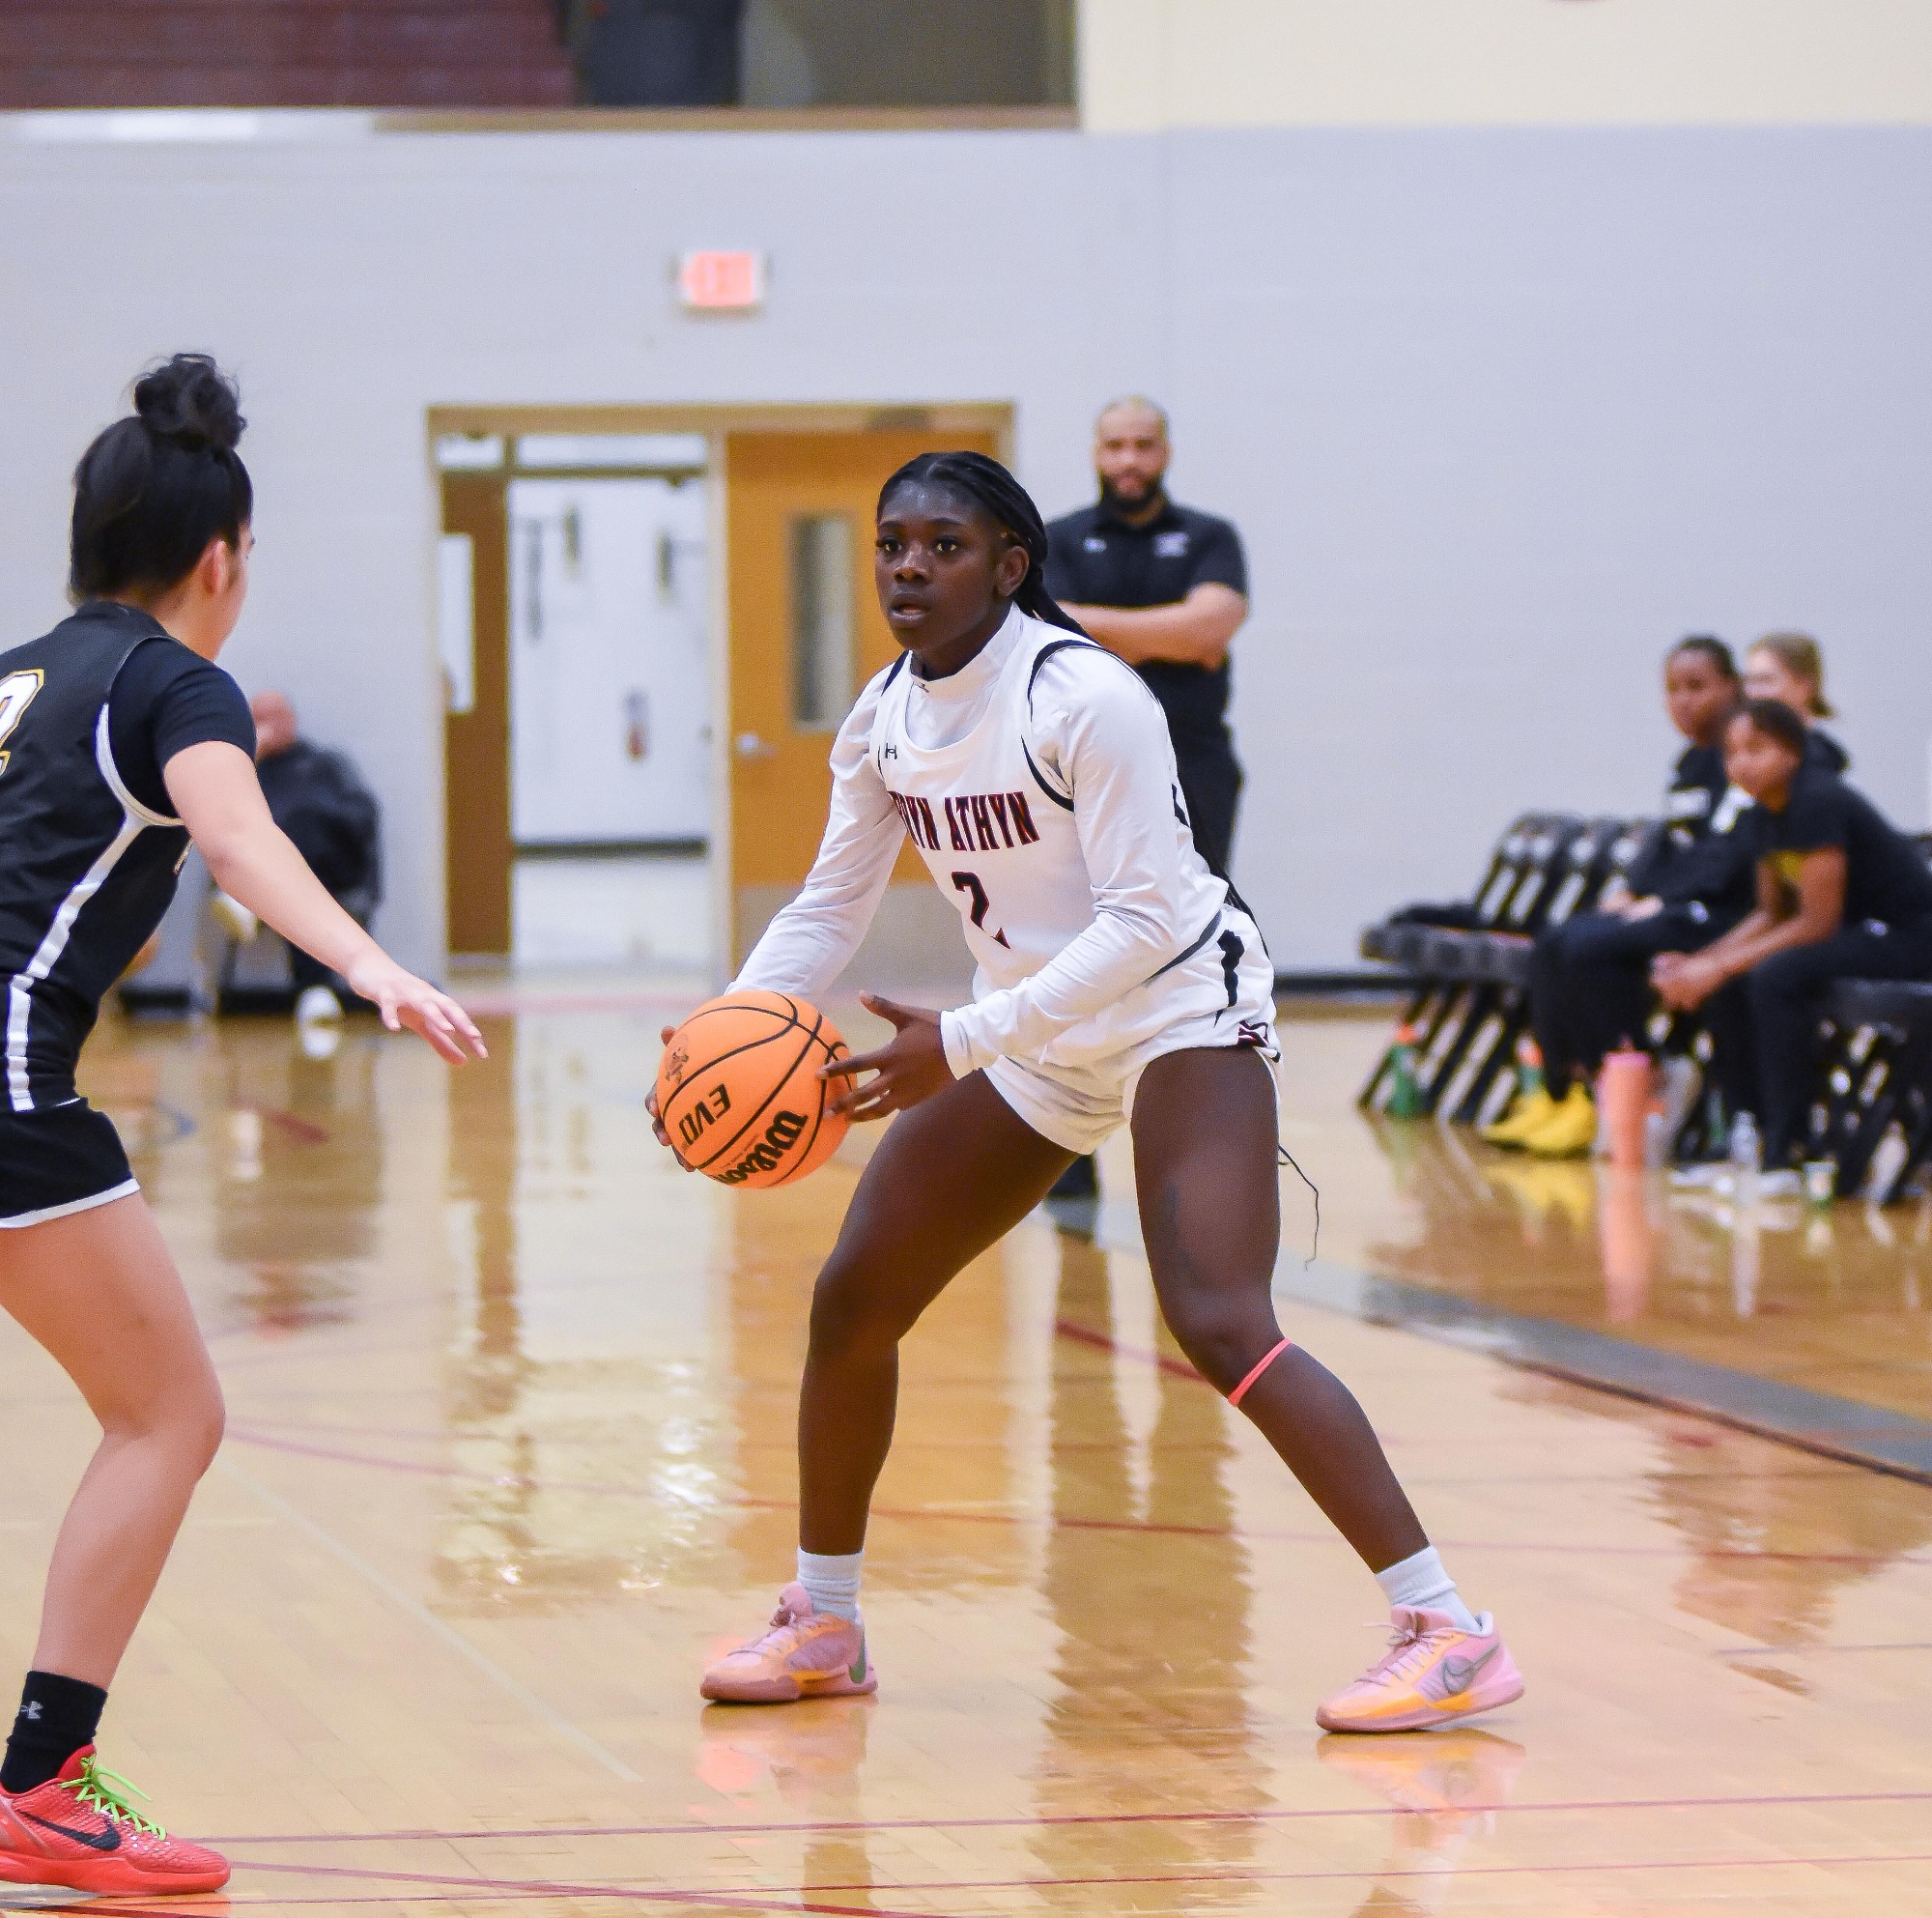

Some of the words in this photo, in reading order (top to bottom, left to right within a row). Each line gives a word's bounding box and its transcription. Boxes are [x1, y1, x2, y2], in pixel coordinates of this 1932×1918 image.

[944, 790, 1040, 851] ATHYN
[952, 872, 1010, 949] 2
[678, 1083, 731, 1146] EVO
